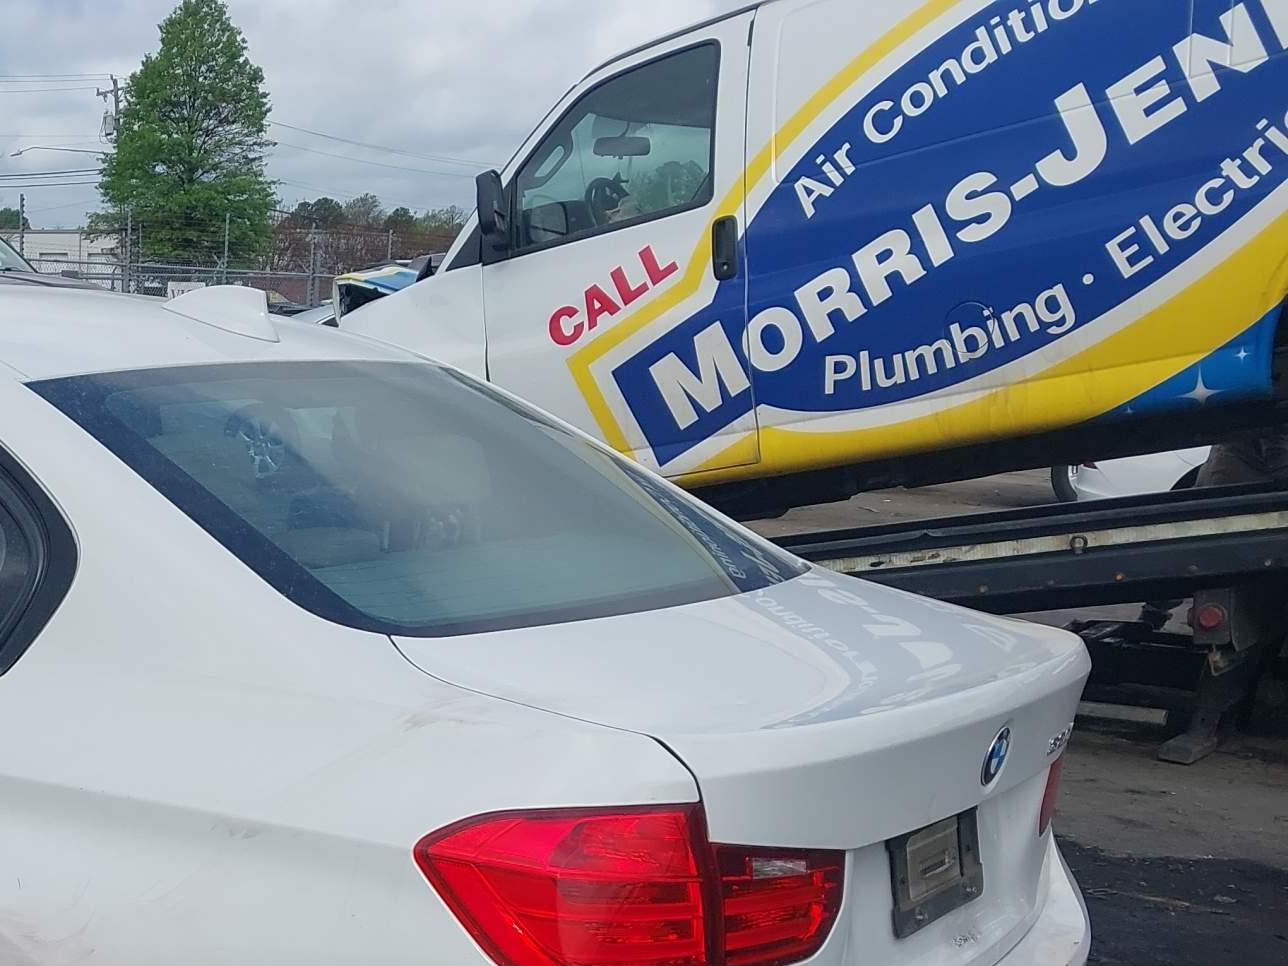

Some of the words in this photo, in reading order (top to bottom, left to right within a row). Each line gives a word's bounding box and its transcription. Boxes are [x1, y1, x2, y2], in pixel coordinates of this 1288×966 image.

[794, 142, 856, 219] Air
[863, 0, 1100, 144] Conditio
[547, 244, 680, 347] CALL
[824, 283, 1076, 395] Plumbing
[1105, 110, 1288, 279] Electri
